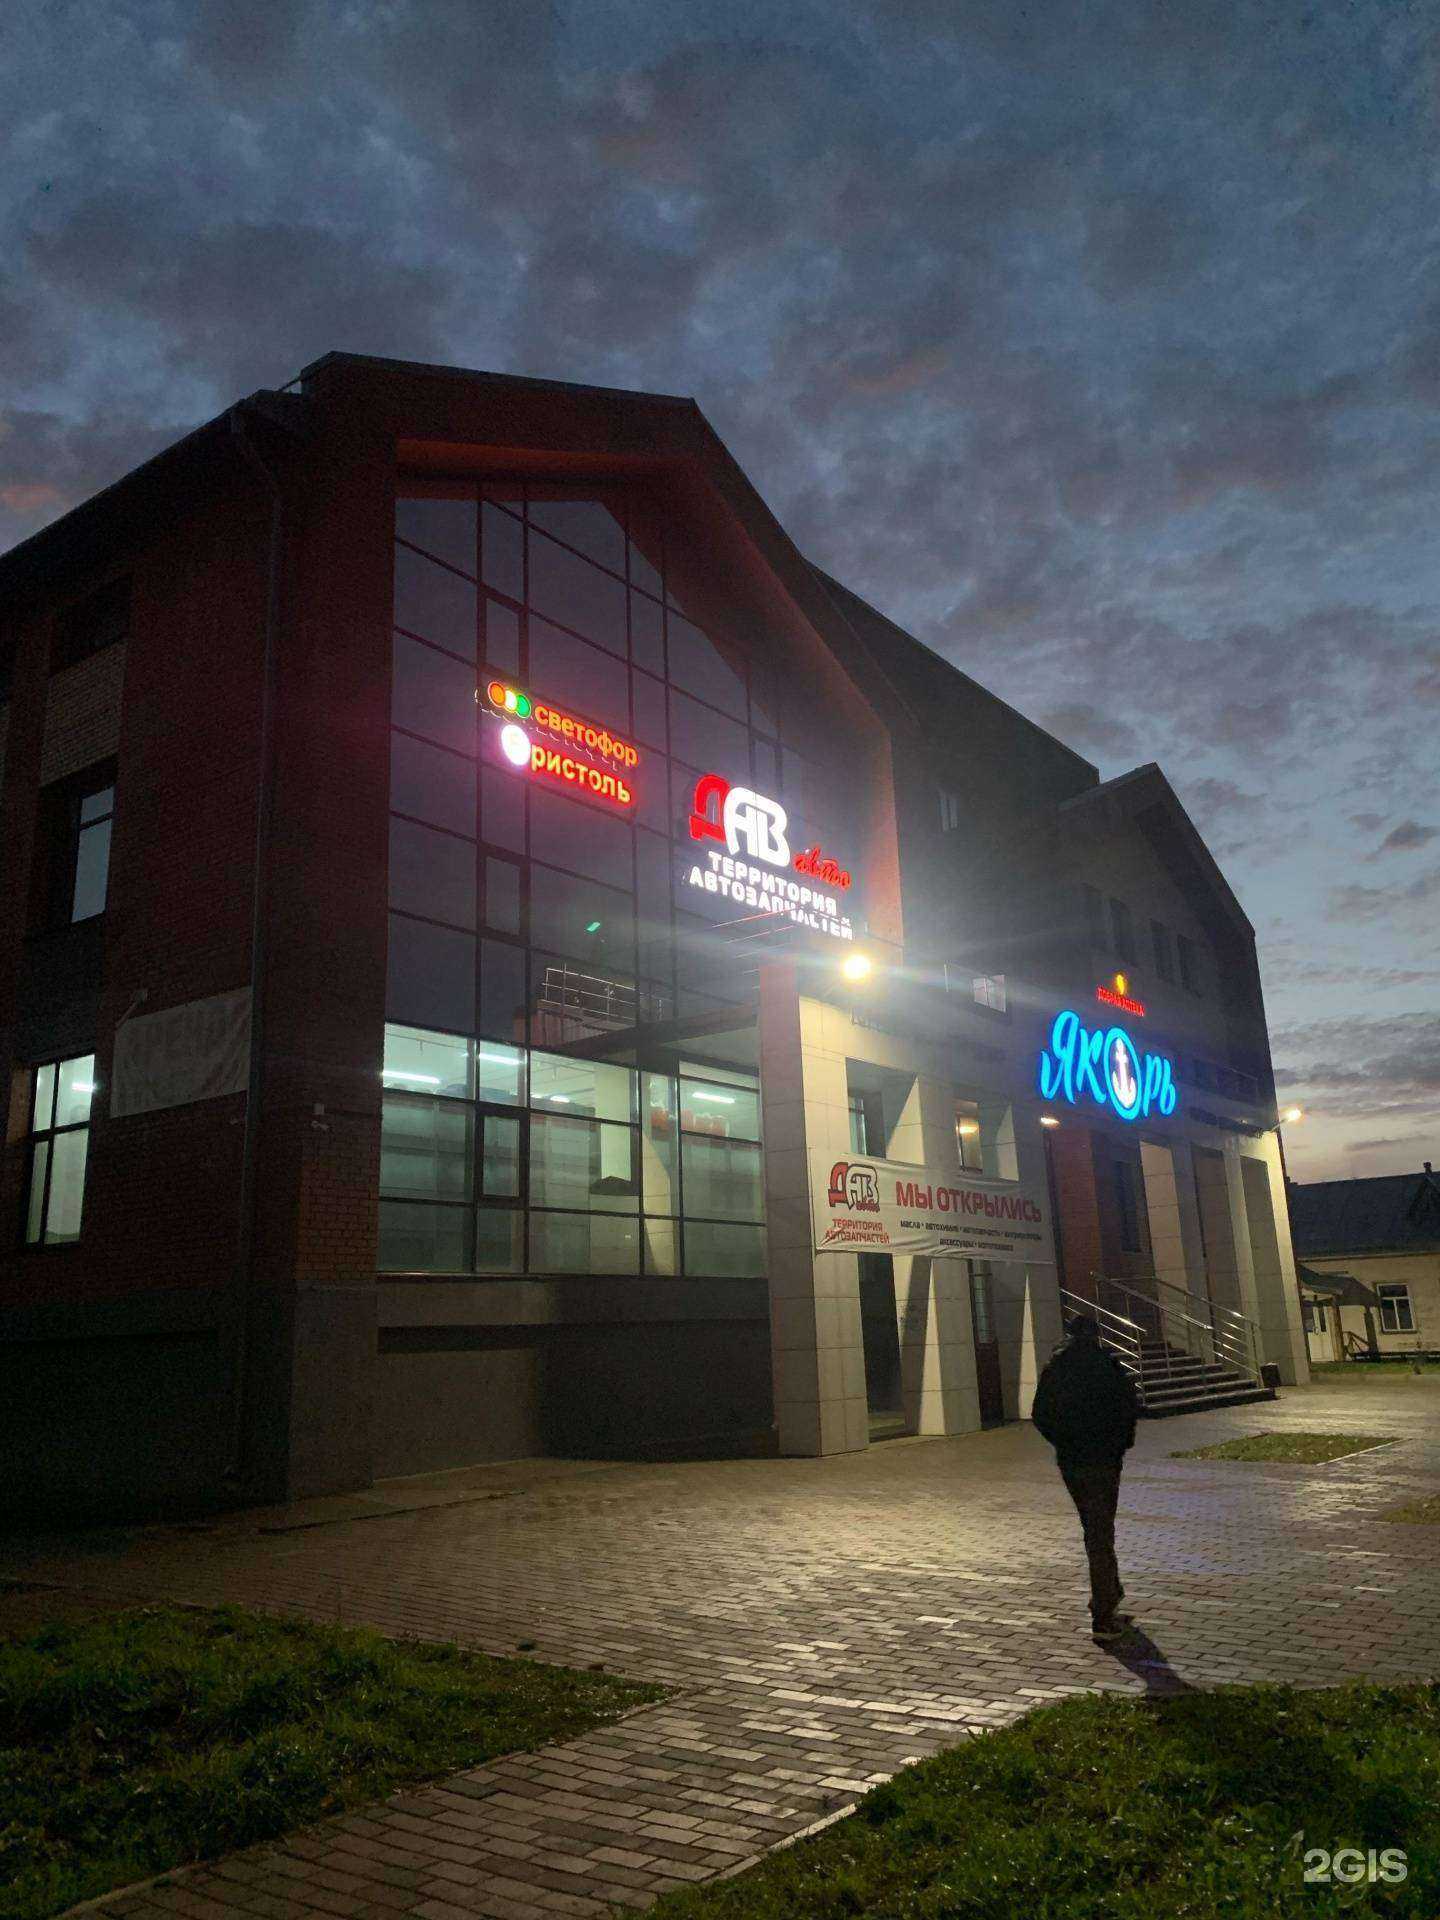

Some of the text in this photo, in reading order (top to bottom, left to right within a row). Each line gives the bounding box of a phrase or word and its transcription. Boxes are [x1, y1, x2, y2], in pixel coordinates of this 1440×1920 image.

[501, 725, 632, 803] ристоль
[535, 705, 639, 767] светофор
[707, 851, 837, 916] ТЕРРИТОРИЯ
[832, 1218, 883, 1232] ТЕРРИТОРИЯ
[895, 1181, 1042, 1222] МЫ ОТКРЫЛИСЬ
